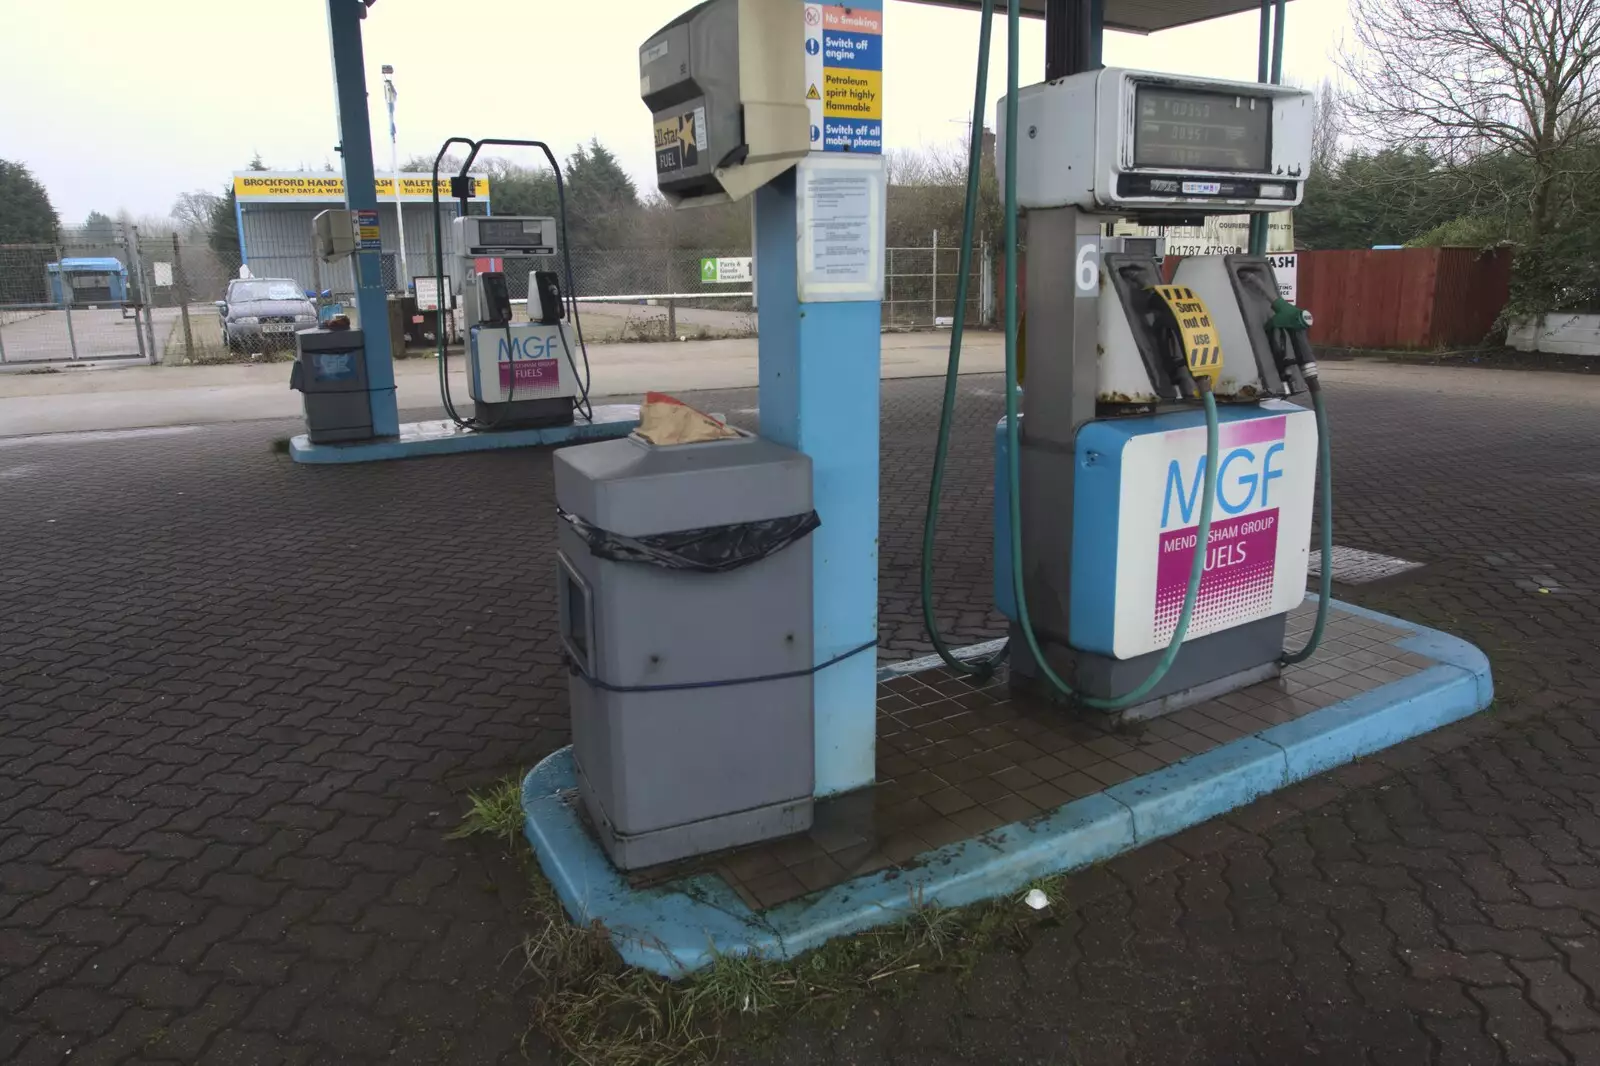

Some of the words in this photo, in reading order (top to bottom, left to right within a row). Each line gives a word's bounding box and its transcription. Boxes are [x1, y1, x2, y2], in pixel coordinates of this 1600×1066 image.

[826, 13, 838, 24] No
[841, 15, 879, 30] Smoking
[826, 37, 854, 49] Switch
[856, 40, 868, 50] off
[826, 49, 855, 61] engine
[826, 75, 868, 86] Petroleum
[826, 88, 847, 98] spirit
[850, 89, 876, 102] highly
[826, 100, 871, 112] flammable
[826, 124, 853, 135] Switch
[856, 125, 868, 136] off
[870, 126, 881, 137] all
[826, 136, 851, 146] mobile
[854, 137, 881, 148] phones
[660, 152, 676, 168] FUEL
[243, 178, 304, 187] BROCKFORD
[308, 179, 334, 187] HAND
[1169, 246, 1200, 256] 01787
[1204, 246, 1242, 256] 47959
[1075, 243, 1097, 291] 6
[1266, 257, 1295, 268] ASH
[467, 269, 476, 284] 4
[1176, 302, 1203, 314] Sorry
[1183, 317, 1200, 329] out
[1200, 315, 1210, 328] of
[1193, 334, 1210, 346] use
[498, 334, 557, 361] MGF
[515, 368, 543, 378] FUELS
[1161, 442, 1284, 528] MGF
[1164, 525, 1239, 553] MENDSHAM
[1241, 517, 1275, 535] GROUP
[1203, 541, 1247, 571] UELS
